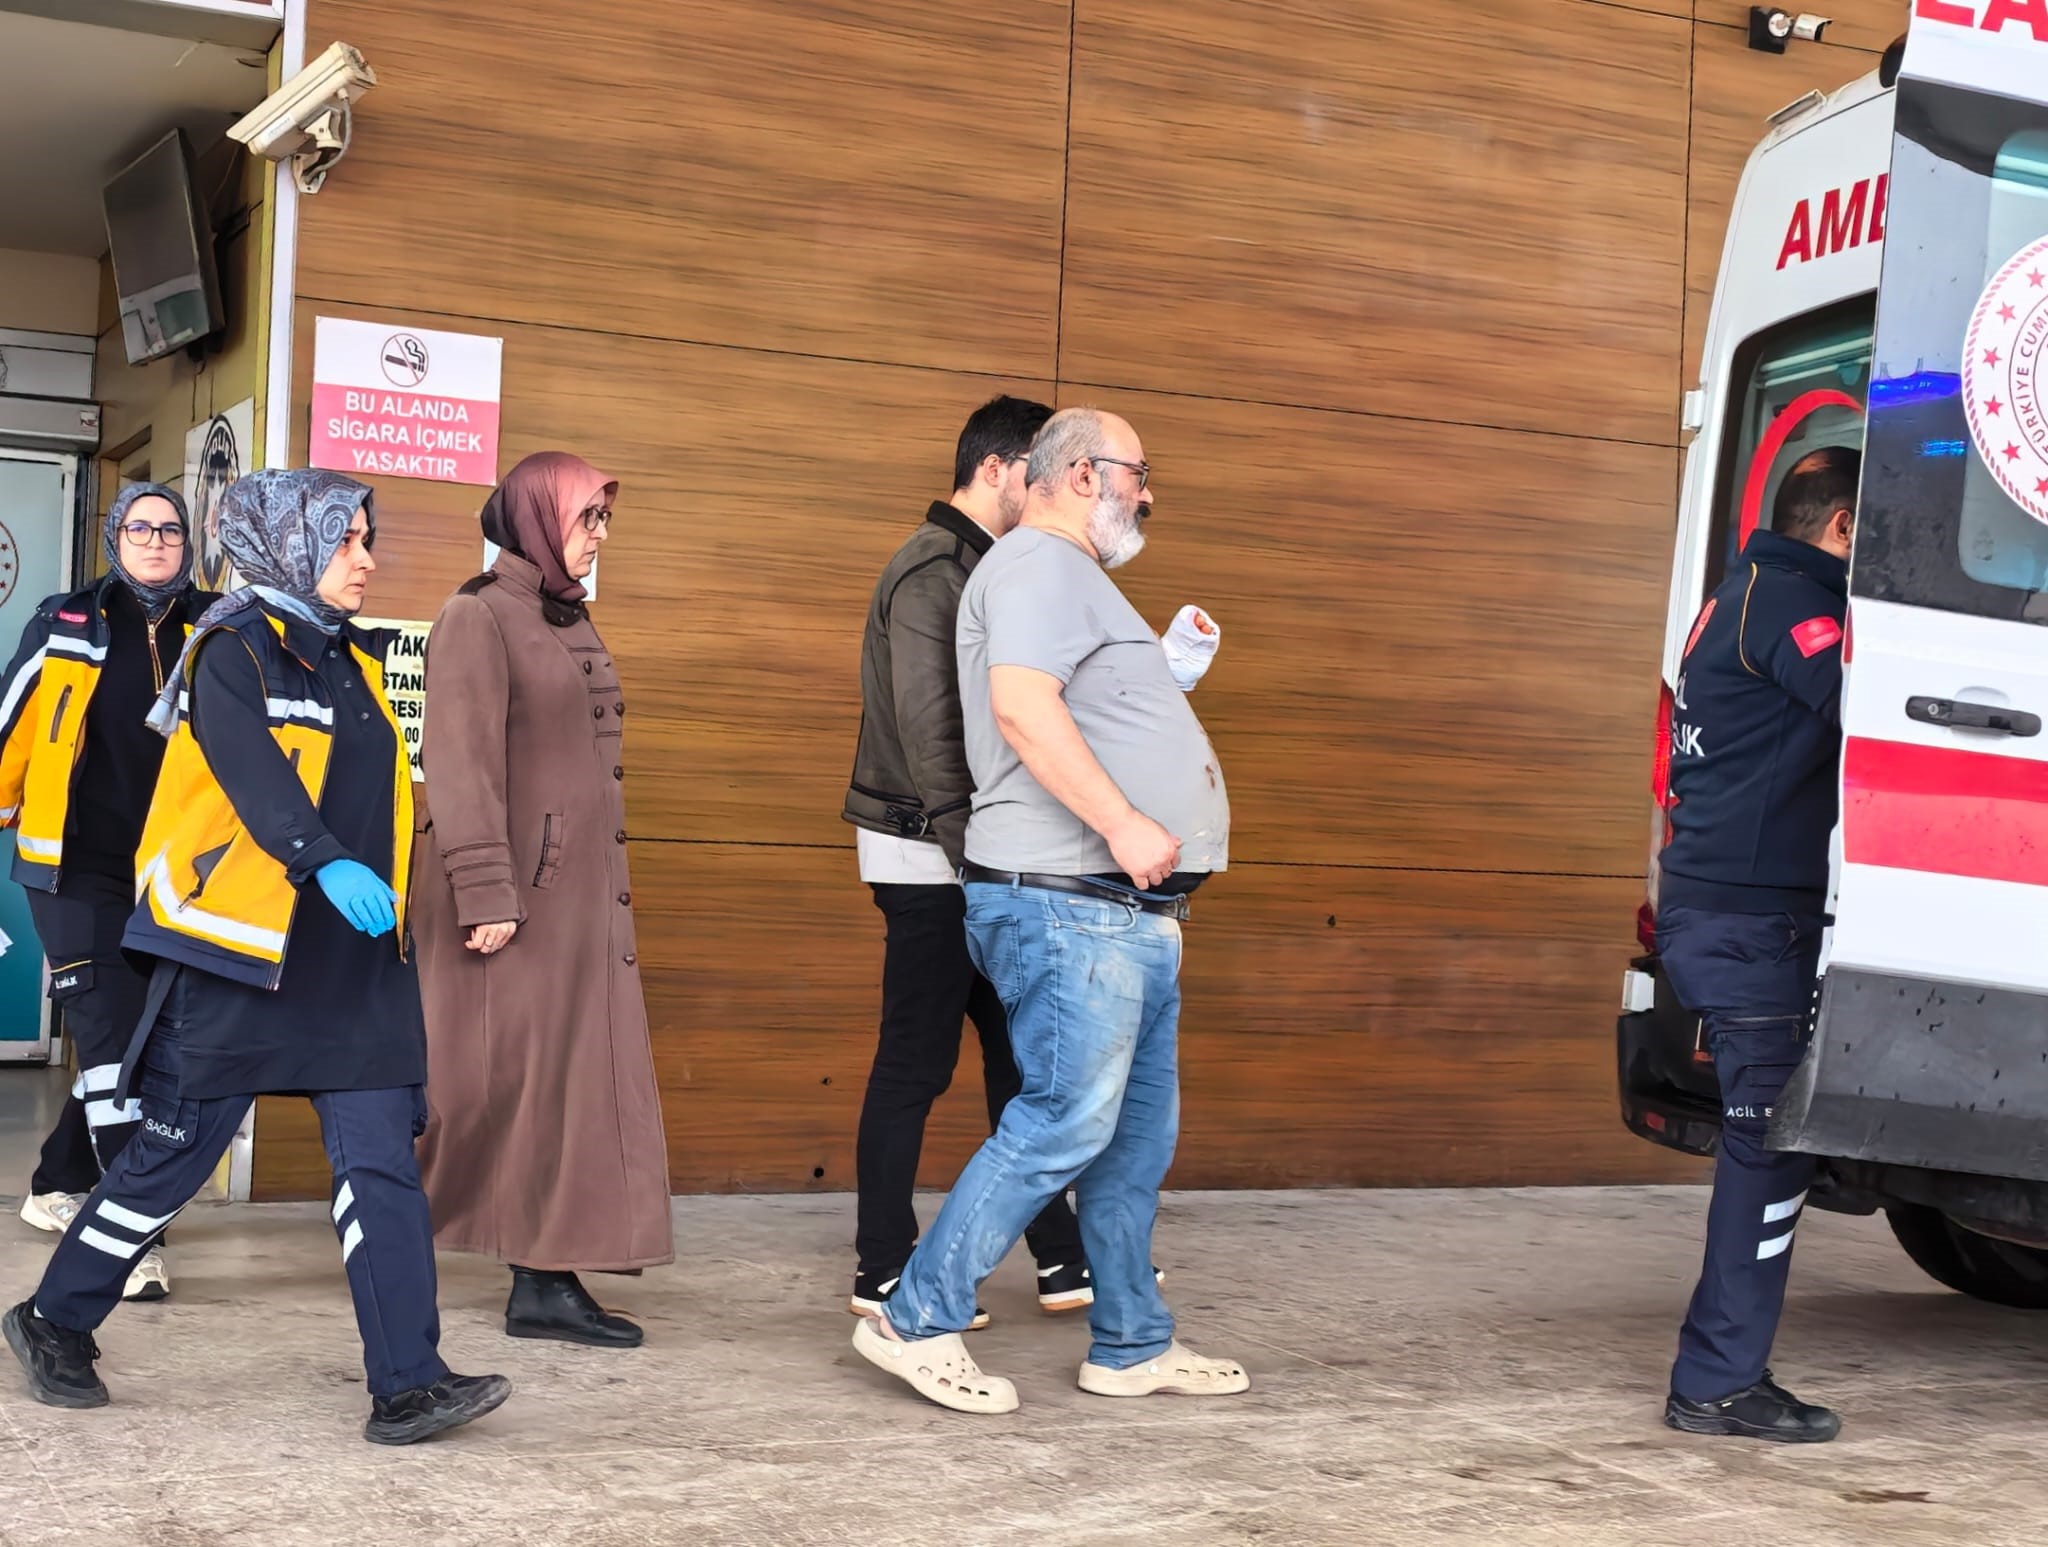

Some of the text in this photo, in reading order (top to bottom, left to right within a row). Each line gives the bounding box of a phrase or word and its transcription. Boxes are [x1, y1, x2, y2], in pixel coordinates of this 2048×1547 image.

[345, 391, 469, 423] BU ALANDA
[328, 416, 482, 453] SİGARA İÇMEK
[351, 449, 457, 478] YASAKTIR
[1726, 1105, 1757, 1118] ACİL
